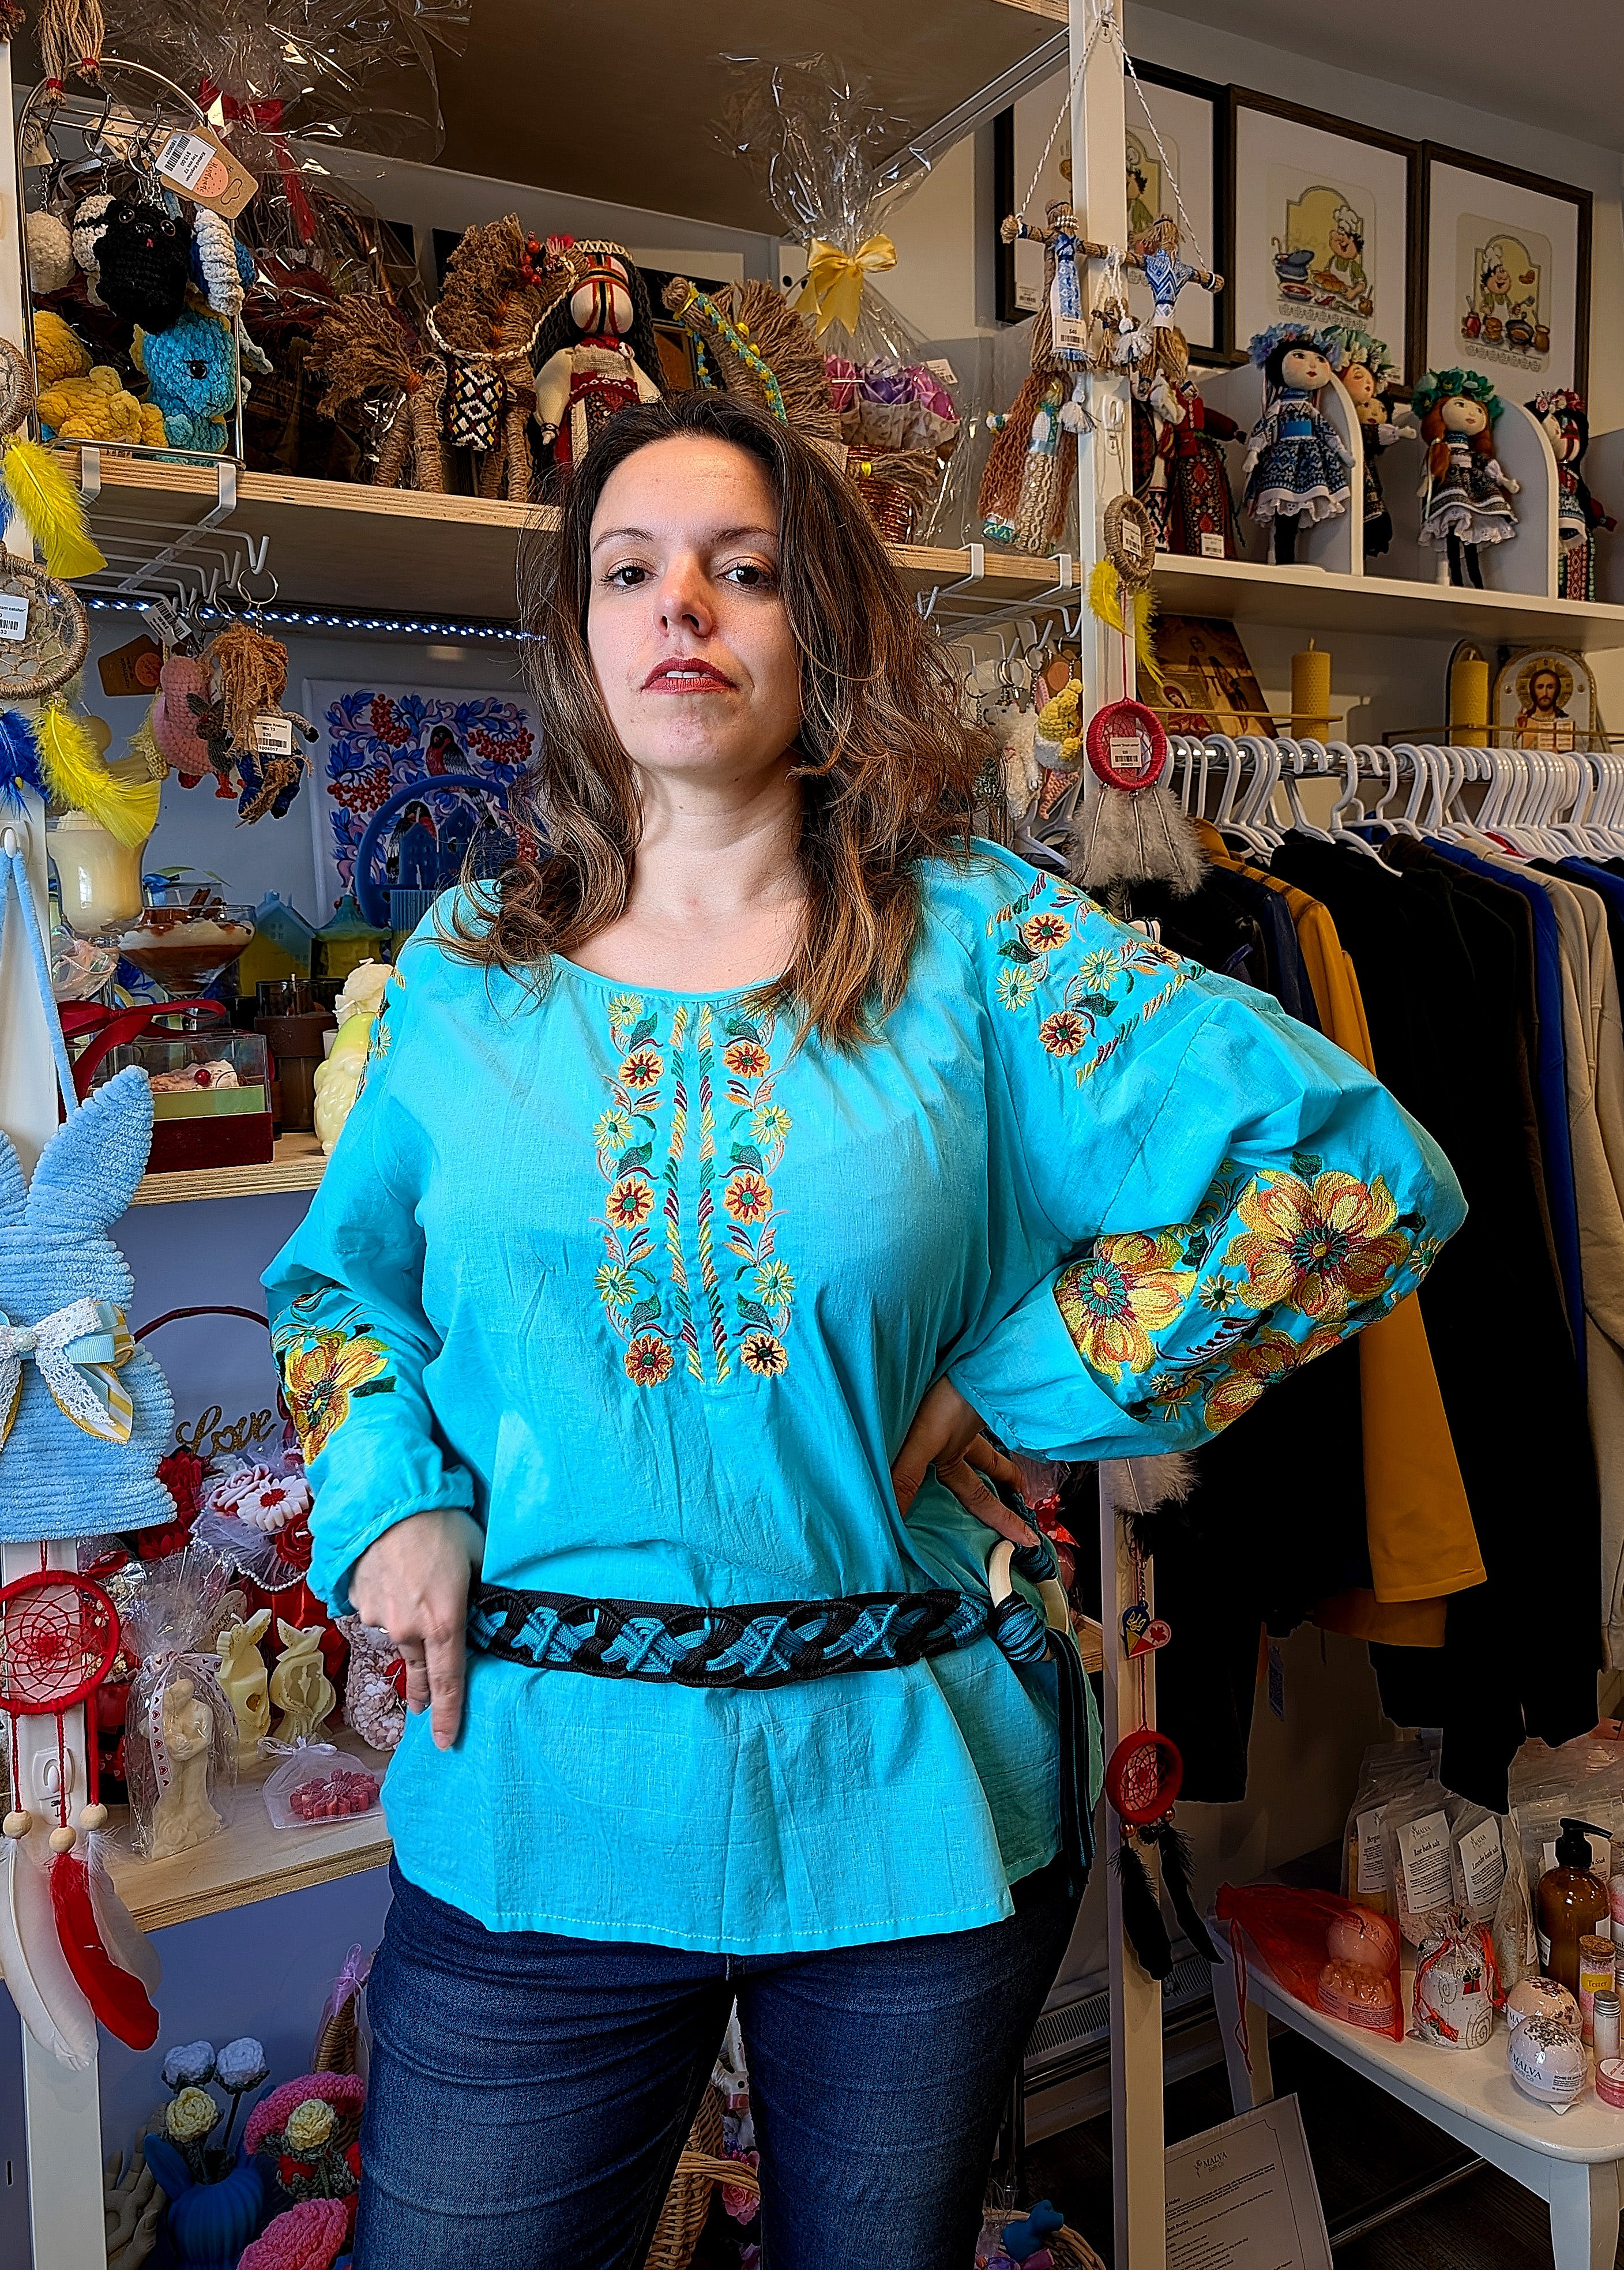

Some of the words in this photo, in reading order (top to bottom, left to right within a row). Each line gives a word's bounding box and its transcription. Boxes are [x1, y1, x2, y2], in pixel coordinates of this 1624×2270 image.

[180, 151, 191, 166] $13.00
[175, 1405, 277, 1457] Love
[1512, 2053, 1542, 2080] MALVA
[1202, 2152, 1228, 2168] MALVA
